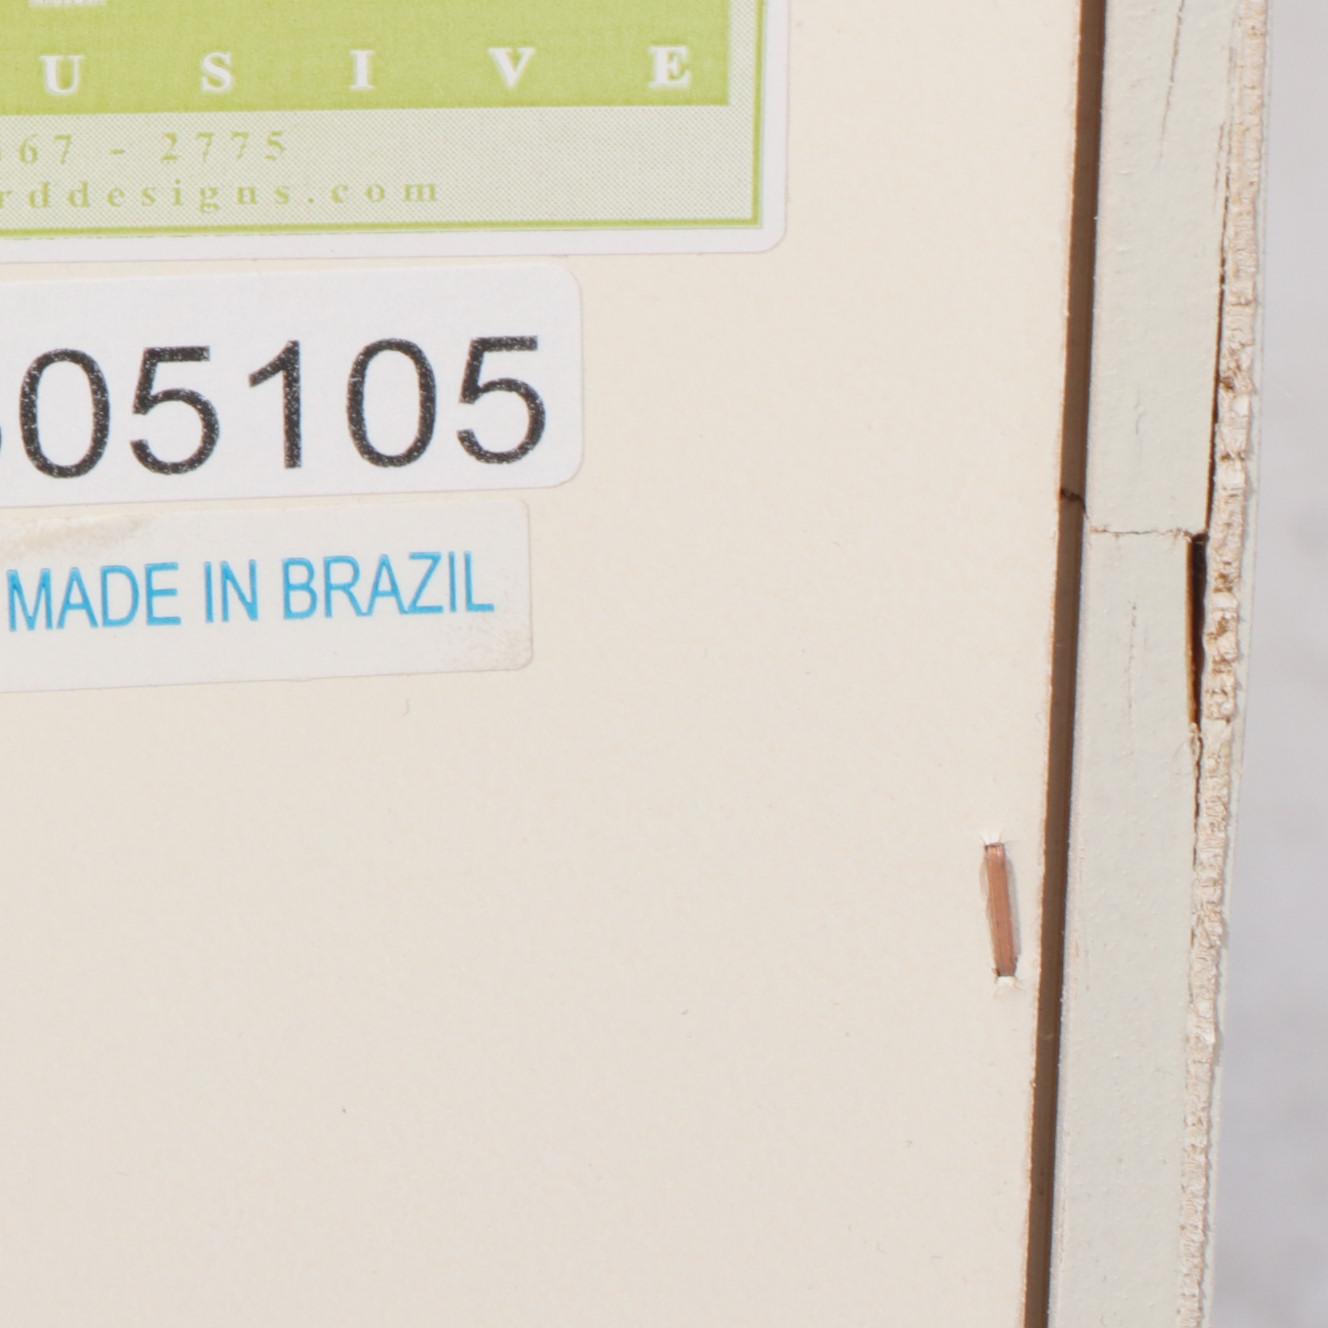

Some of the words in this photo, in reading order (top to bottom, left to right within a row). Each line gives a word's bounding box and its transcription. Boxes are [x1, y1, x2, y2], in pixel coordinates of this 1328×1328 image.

[6, 561, 182, 632] MADE
[202, 558, 260, 623] IN
[280, 549, 495, 620] BRAZIL
